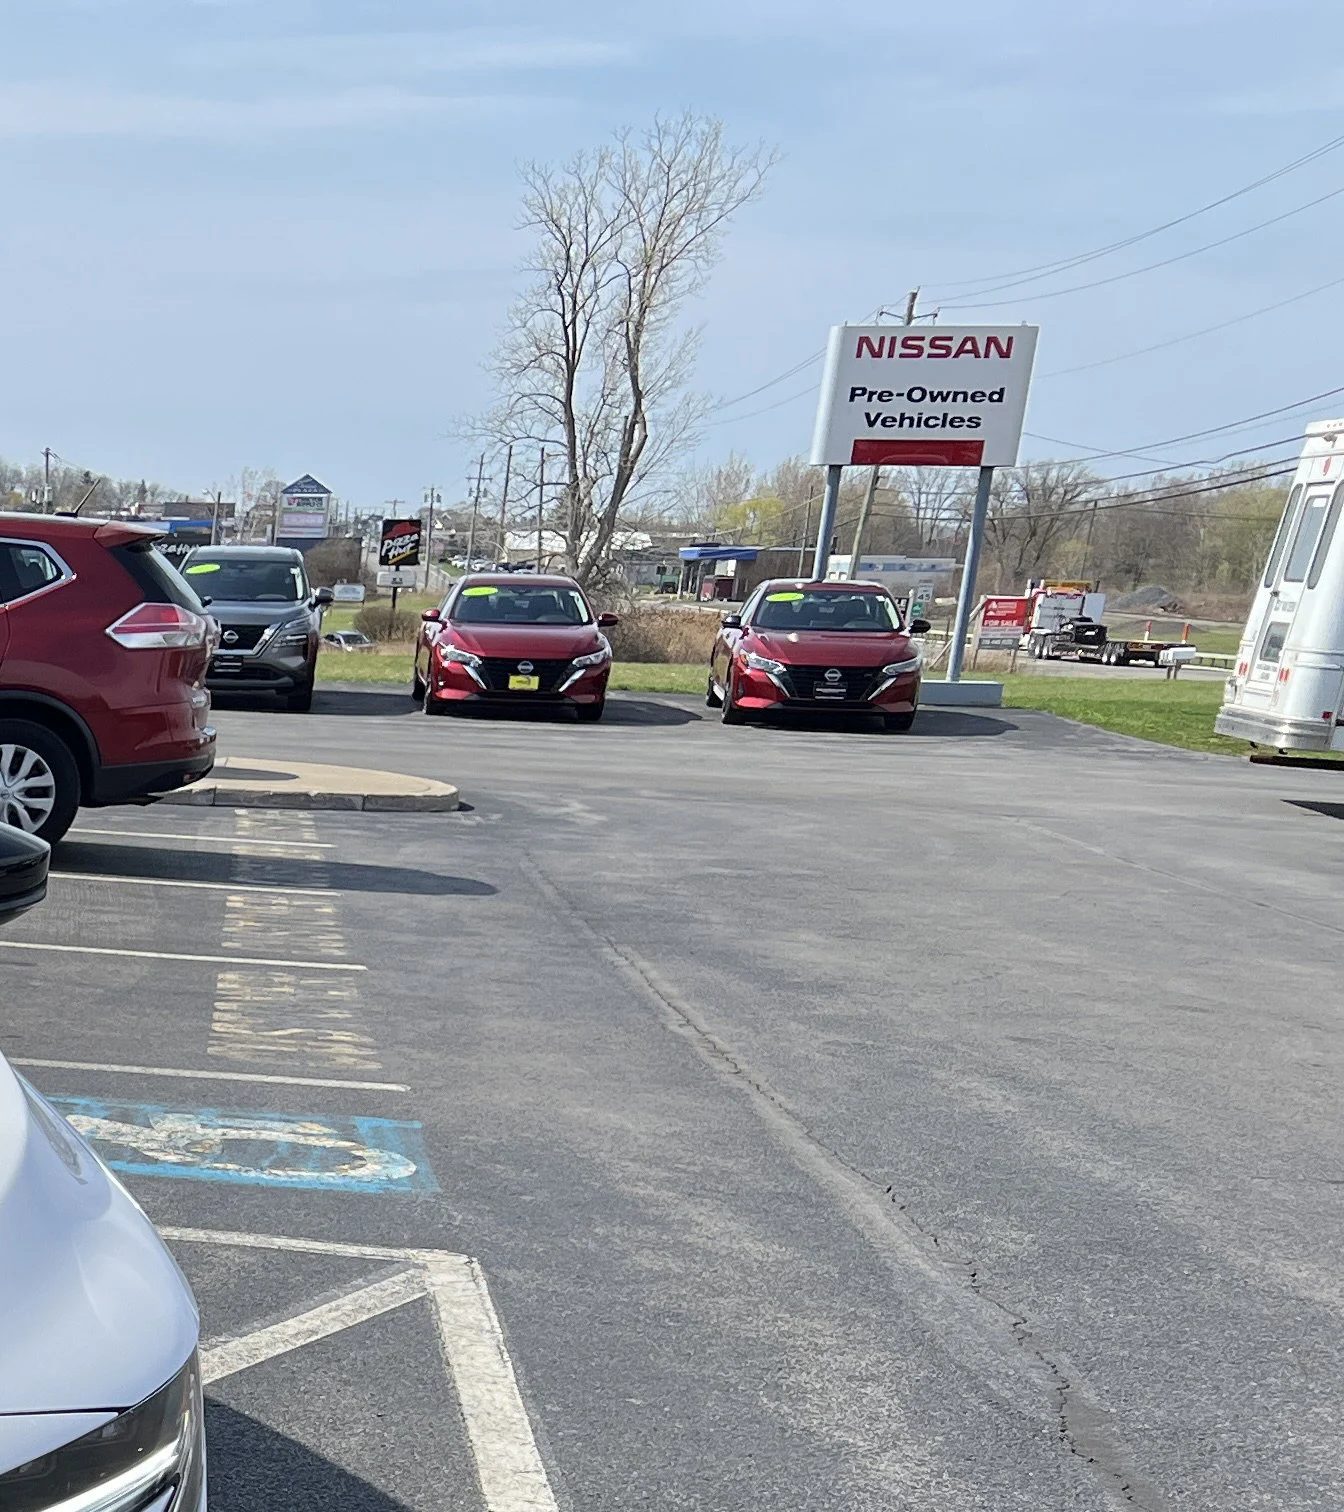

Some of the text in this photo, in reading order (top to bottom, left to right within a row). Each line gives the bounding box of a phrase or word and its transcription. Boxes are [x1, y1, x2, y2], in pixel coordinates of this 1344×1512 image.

[855, 335, 1014, 359] NISSAN
[848, 385, 1006, 404] Pre-Owned
[864, 412, 983, 429] Vehicles
[381, 533, 420, 557] Pizza
[387, 542, 416, 560] Hut
